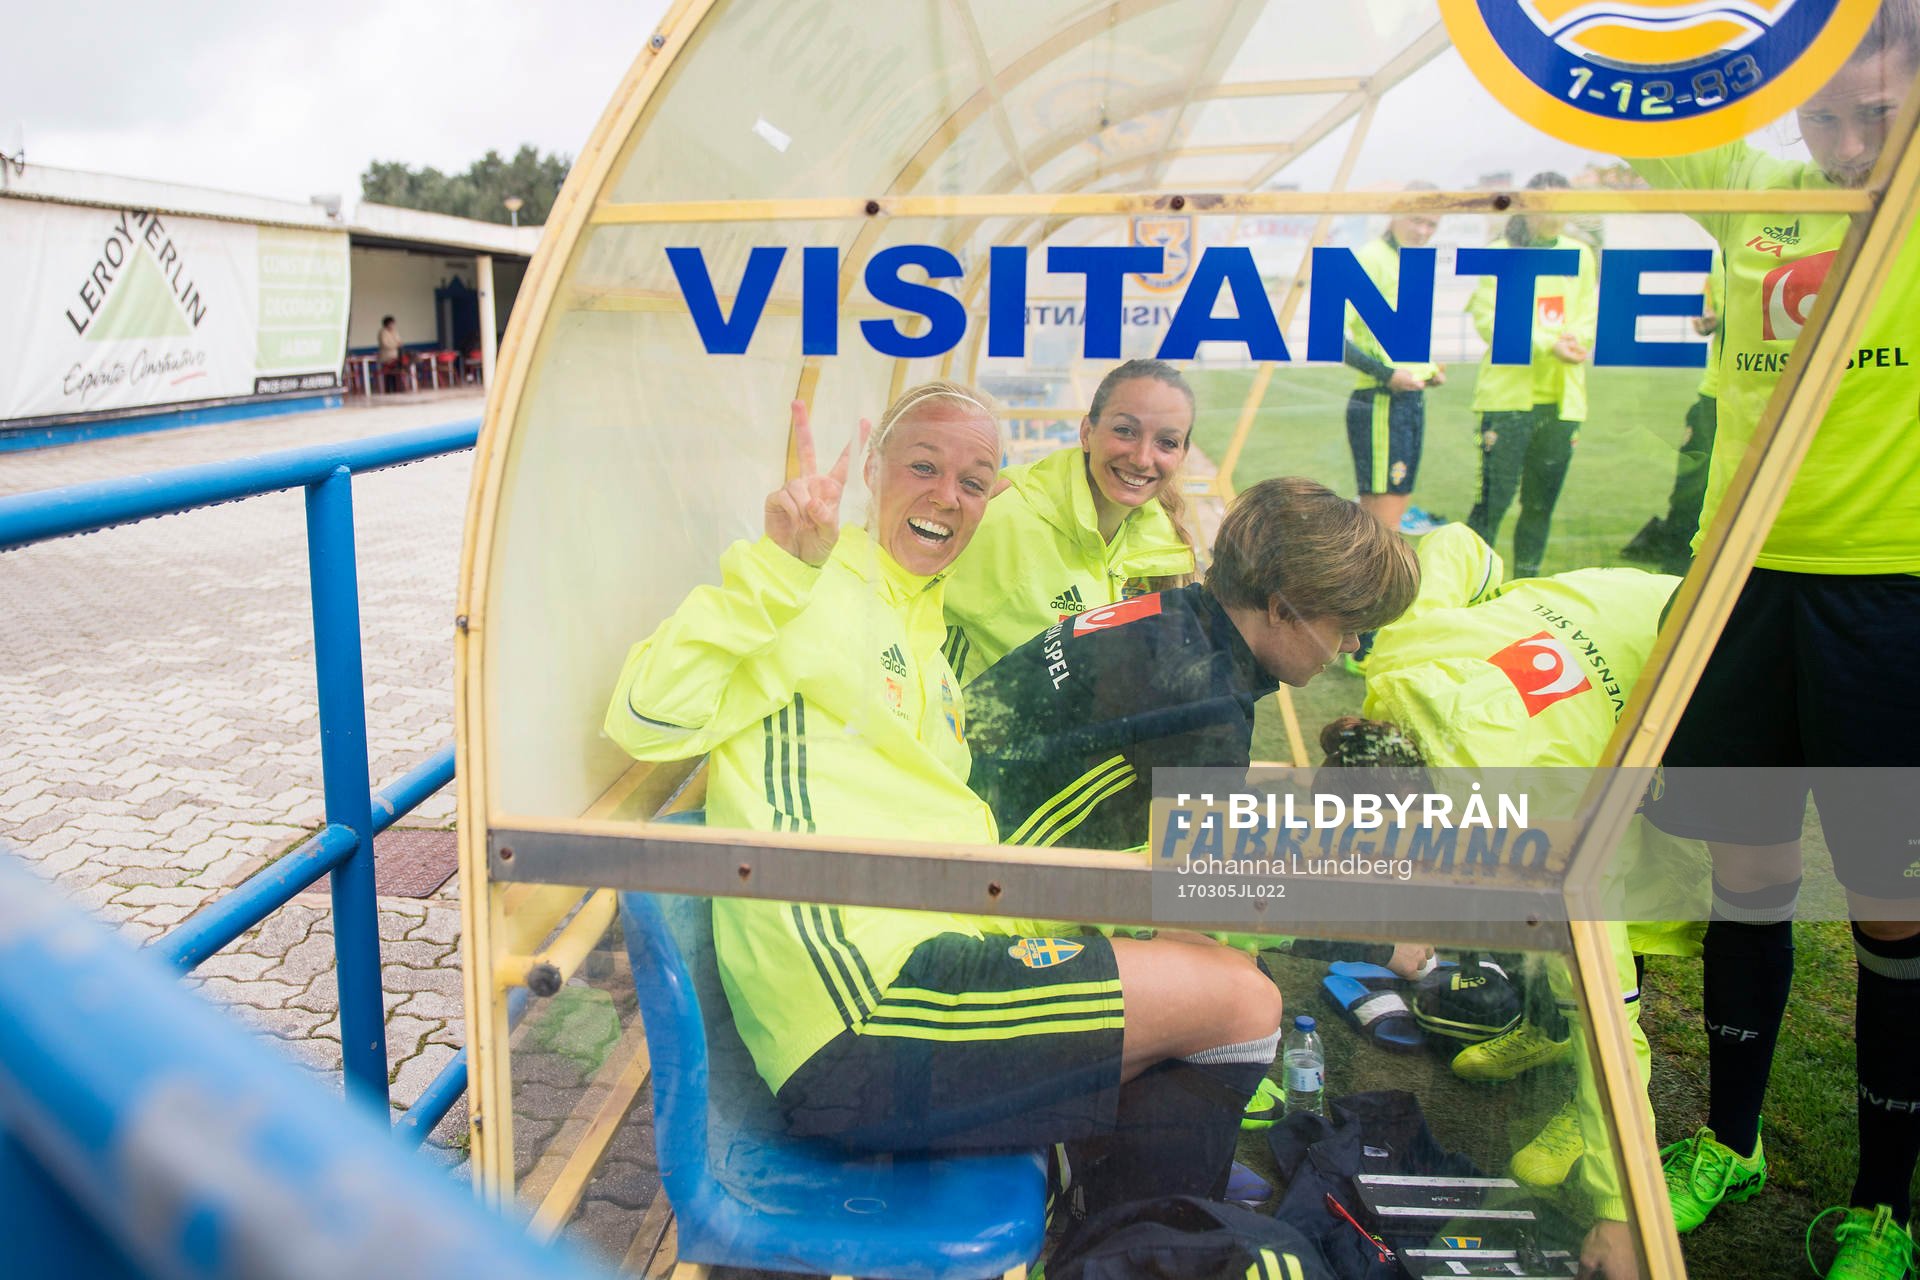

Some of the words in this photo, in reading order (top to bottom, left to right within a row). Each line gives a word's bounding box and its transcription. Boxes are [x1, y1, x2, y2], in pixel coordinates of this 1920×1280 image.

[1567, 54, 1762, 115] 1-12-83
[1745, 235, 1784, 258] ICA
[1763, 226, 1801, 246] adidas
[66, 210, 133, 335] LEROY
[664, 243, 1713, 368] VISITANTE
[1736, 352, 1790, 372] SVENS
[1050, 600, 1087, 612] adidas
[1532, 603, 1573, 629] SPEL
[1043, 640, 1070, 690] SPEL
[1161, 809, 1553, 877] FABRIGIMNO
[1705, 1018, 1759, 1041] VFF
